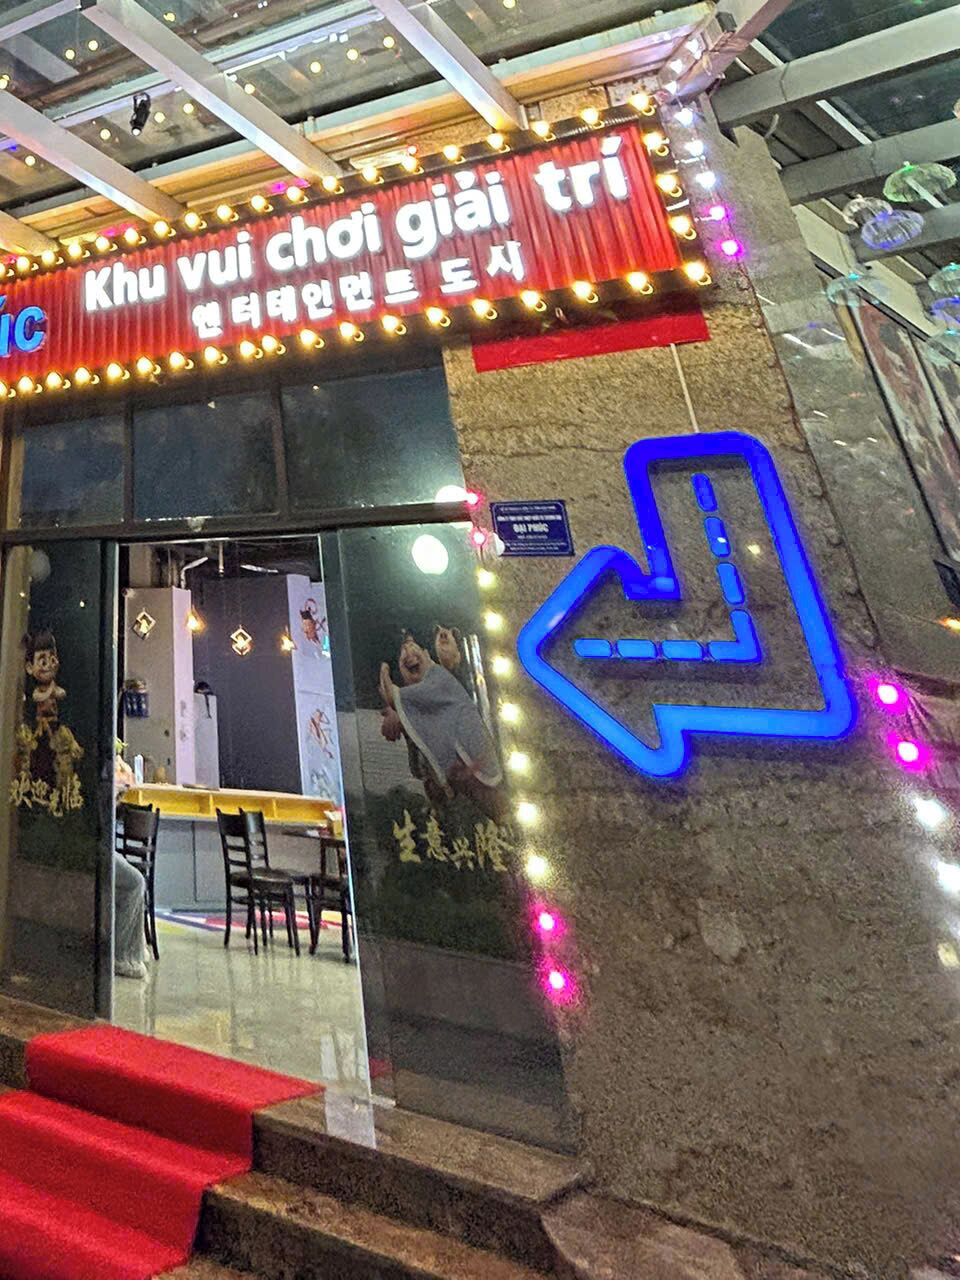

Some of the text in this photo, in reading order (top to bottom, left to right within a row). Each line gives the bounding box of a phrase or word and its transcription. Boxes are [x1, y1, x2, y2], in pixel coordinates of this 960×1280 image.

[84, 135, 629, 312] Khu vui chơi giải trí
